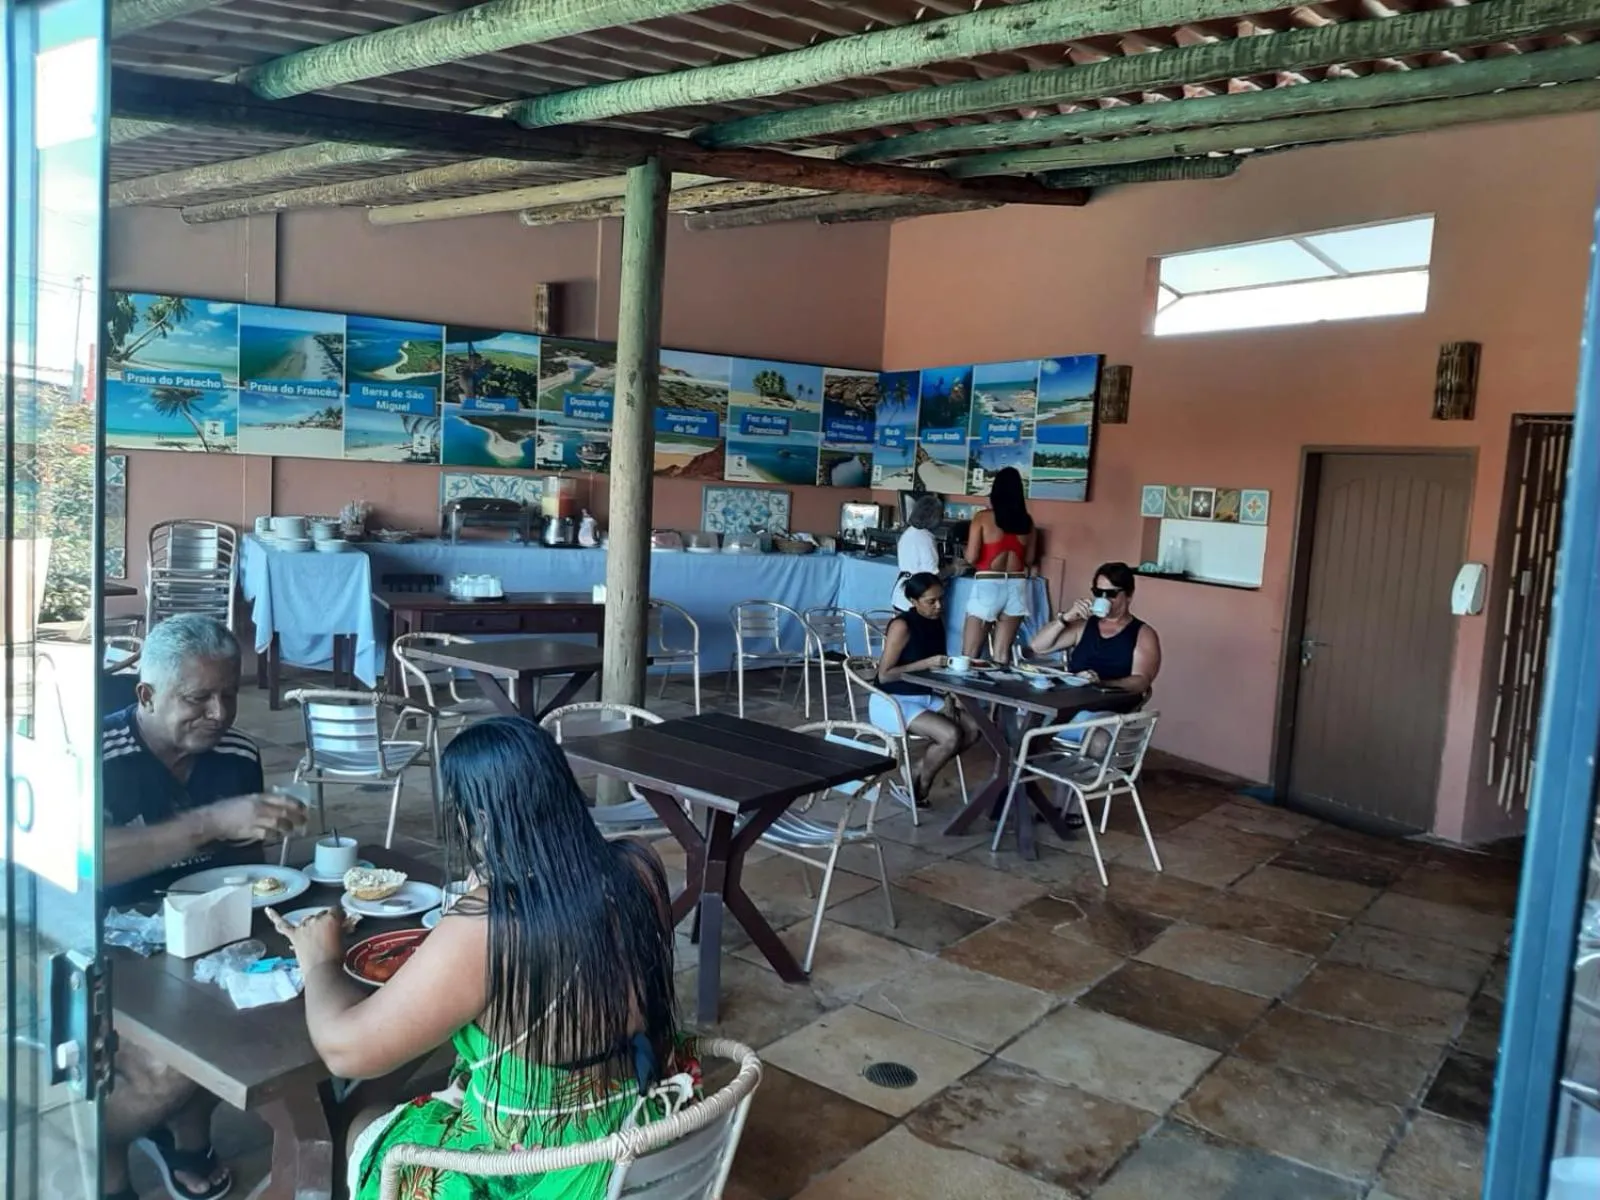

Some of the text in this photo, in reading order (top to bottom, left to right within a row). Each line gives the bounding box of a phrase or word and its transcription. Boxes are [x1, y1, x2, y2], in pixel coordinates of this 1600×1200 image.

[127, 372, 221, 388] Praia do Patacho
[249, 381, 338, 397] Praia do Francês
[361, 386, 389, 397] Barra
[405, 390, 425, 400] São
[376, 400, 411, 413] Miguel
